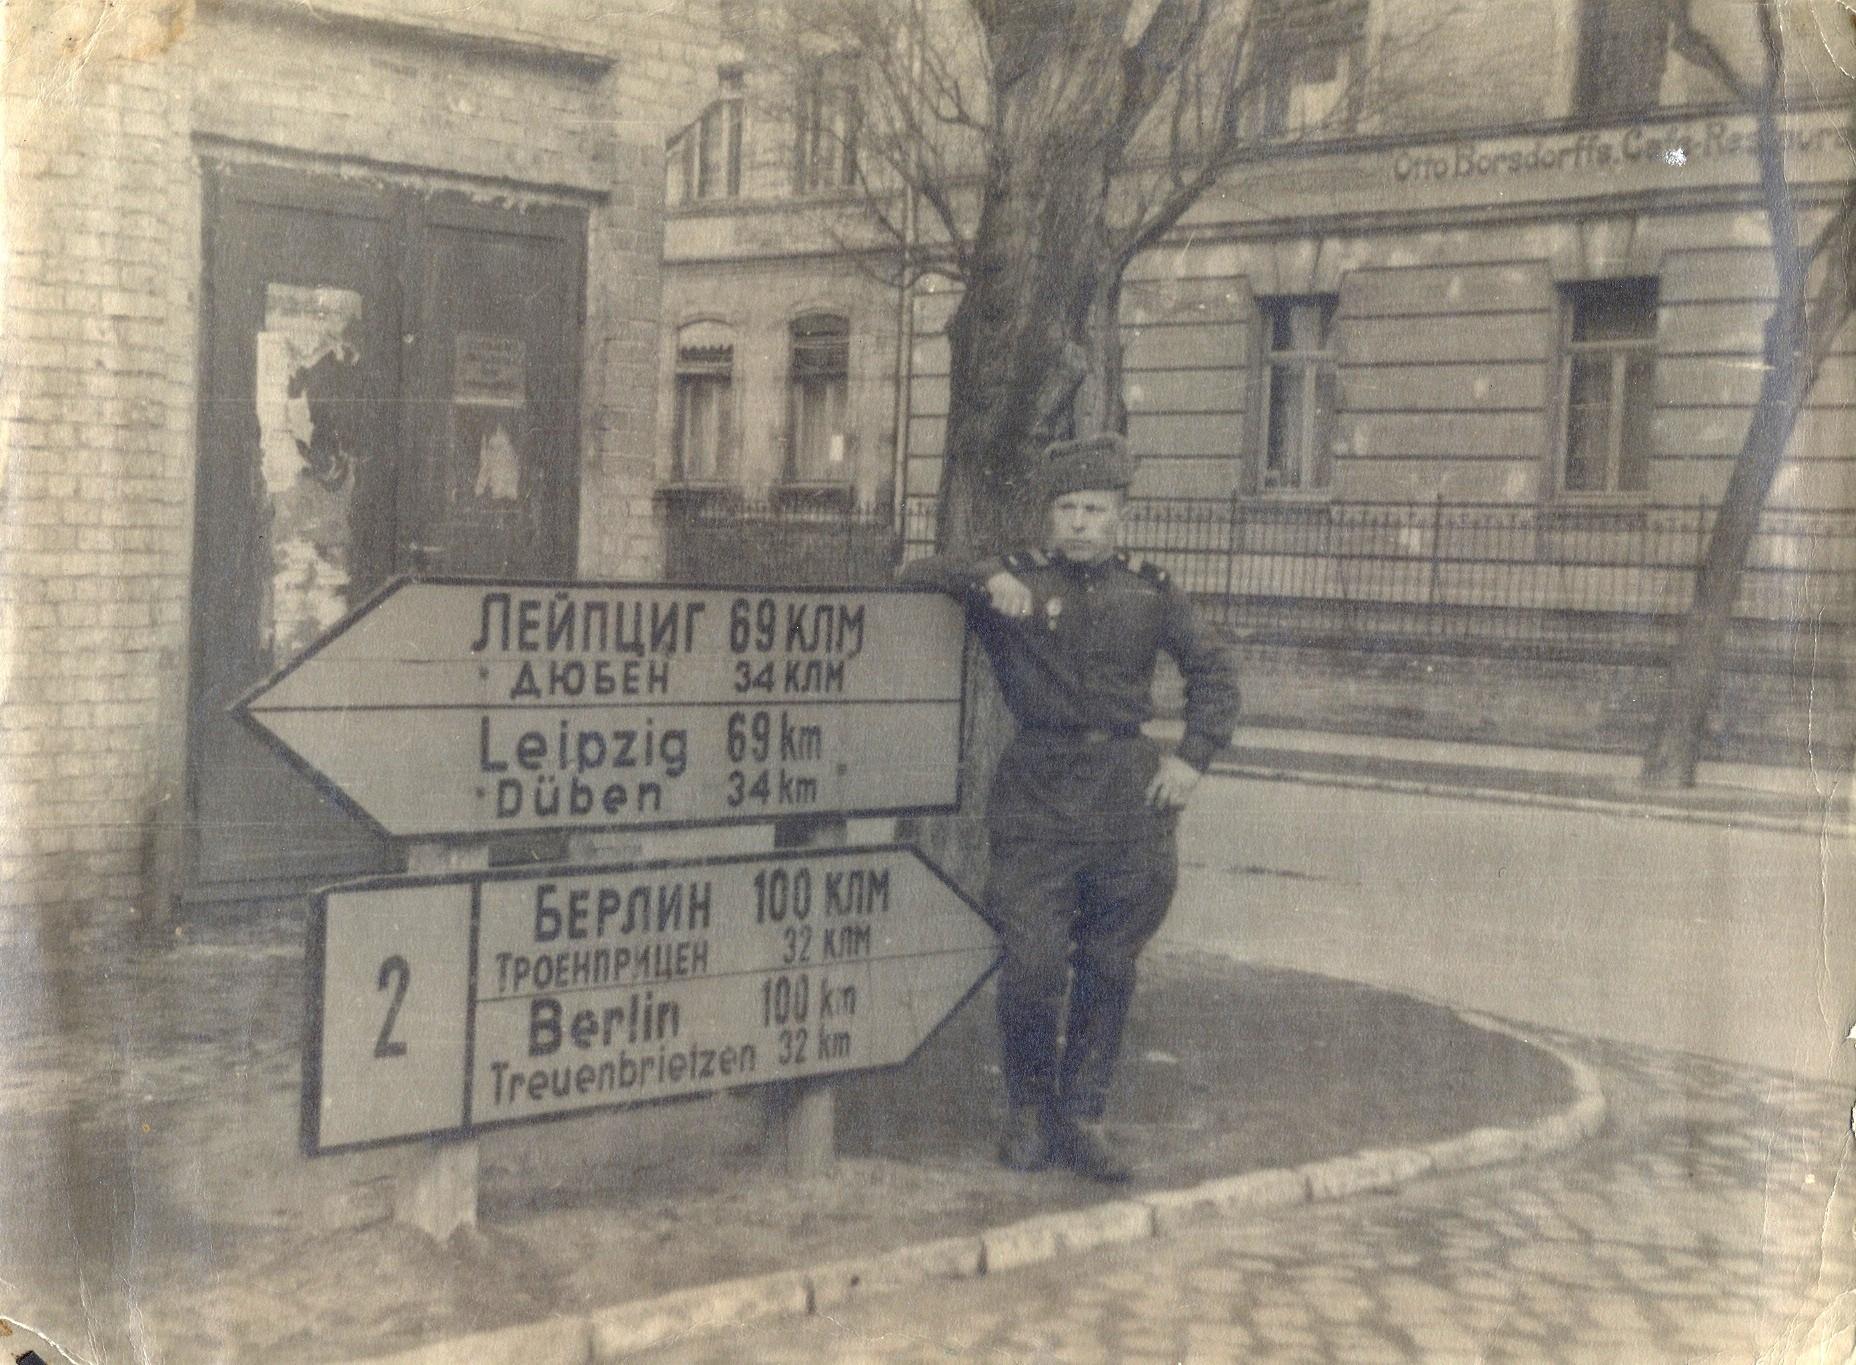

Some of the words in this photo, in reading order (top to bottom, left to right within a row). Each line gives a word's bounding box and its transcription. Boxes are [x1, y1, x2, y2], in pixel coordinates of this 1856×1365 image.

[471, 591, 705, 657] ЛЕЙПЦИГ
[730, 598, 776, 653] 69
[785, 603, 865, 658] КЛМ
[510, 660, 668, 699] ДЮБЕН
[734, 660, 775, 693] 34
[784, 660, 844, 693] КЛМ
[481, 715, 688, 777] Leipzig
[727, 711, 770, 763] 69
[780, 711, 822, 761] km
[497, 774, 662, 818] Düben
[727, 769, 771, 807] 34
[778, 768, 817, 804] km
[534, 881, 712, 942] БЕРЛИН
[754, 867, 811, 924] 100
[825, 867, 890, 917] КЛМ
[495, 940, 709, 993] ТРОЕНПРИЦЕН
[783, 924, 813, 964] 32
[373, 954, 411, 1059] 2
[529, 991, 680, 1057] Berlin
[762, 974, 809, 1029] 100
[491, 1041, 756, 1105] Treuenbrietzen
[779, 1027, 808, 1065] 32
[818, 1024, 851, 1060] km
